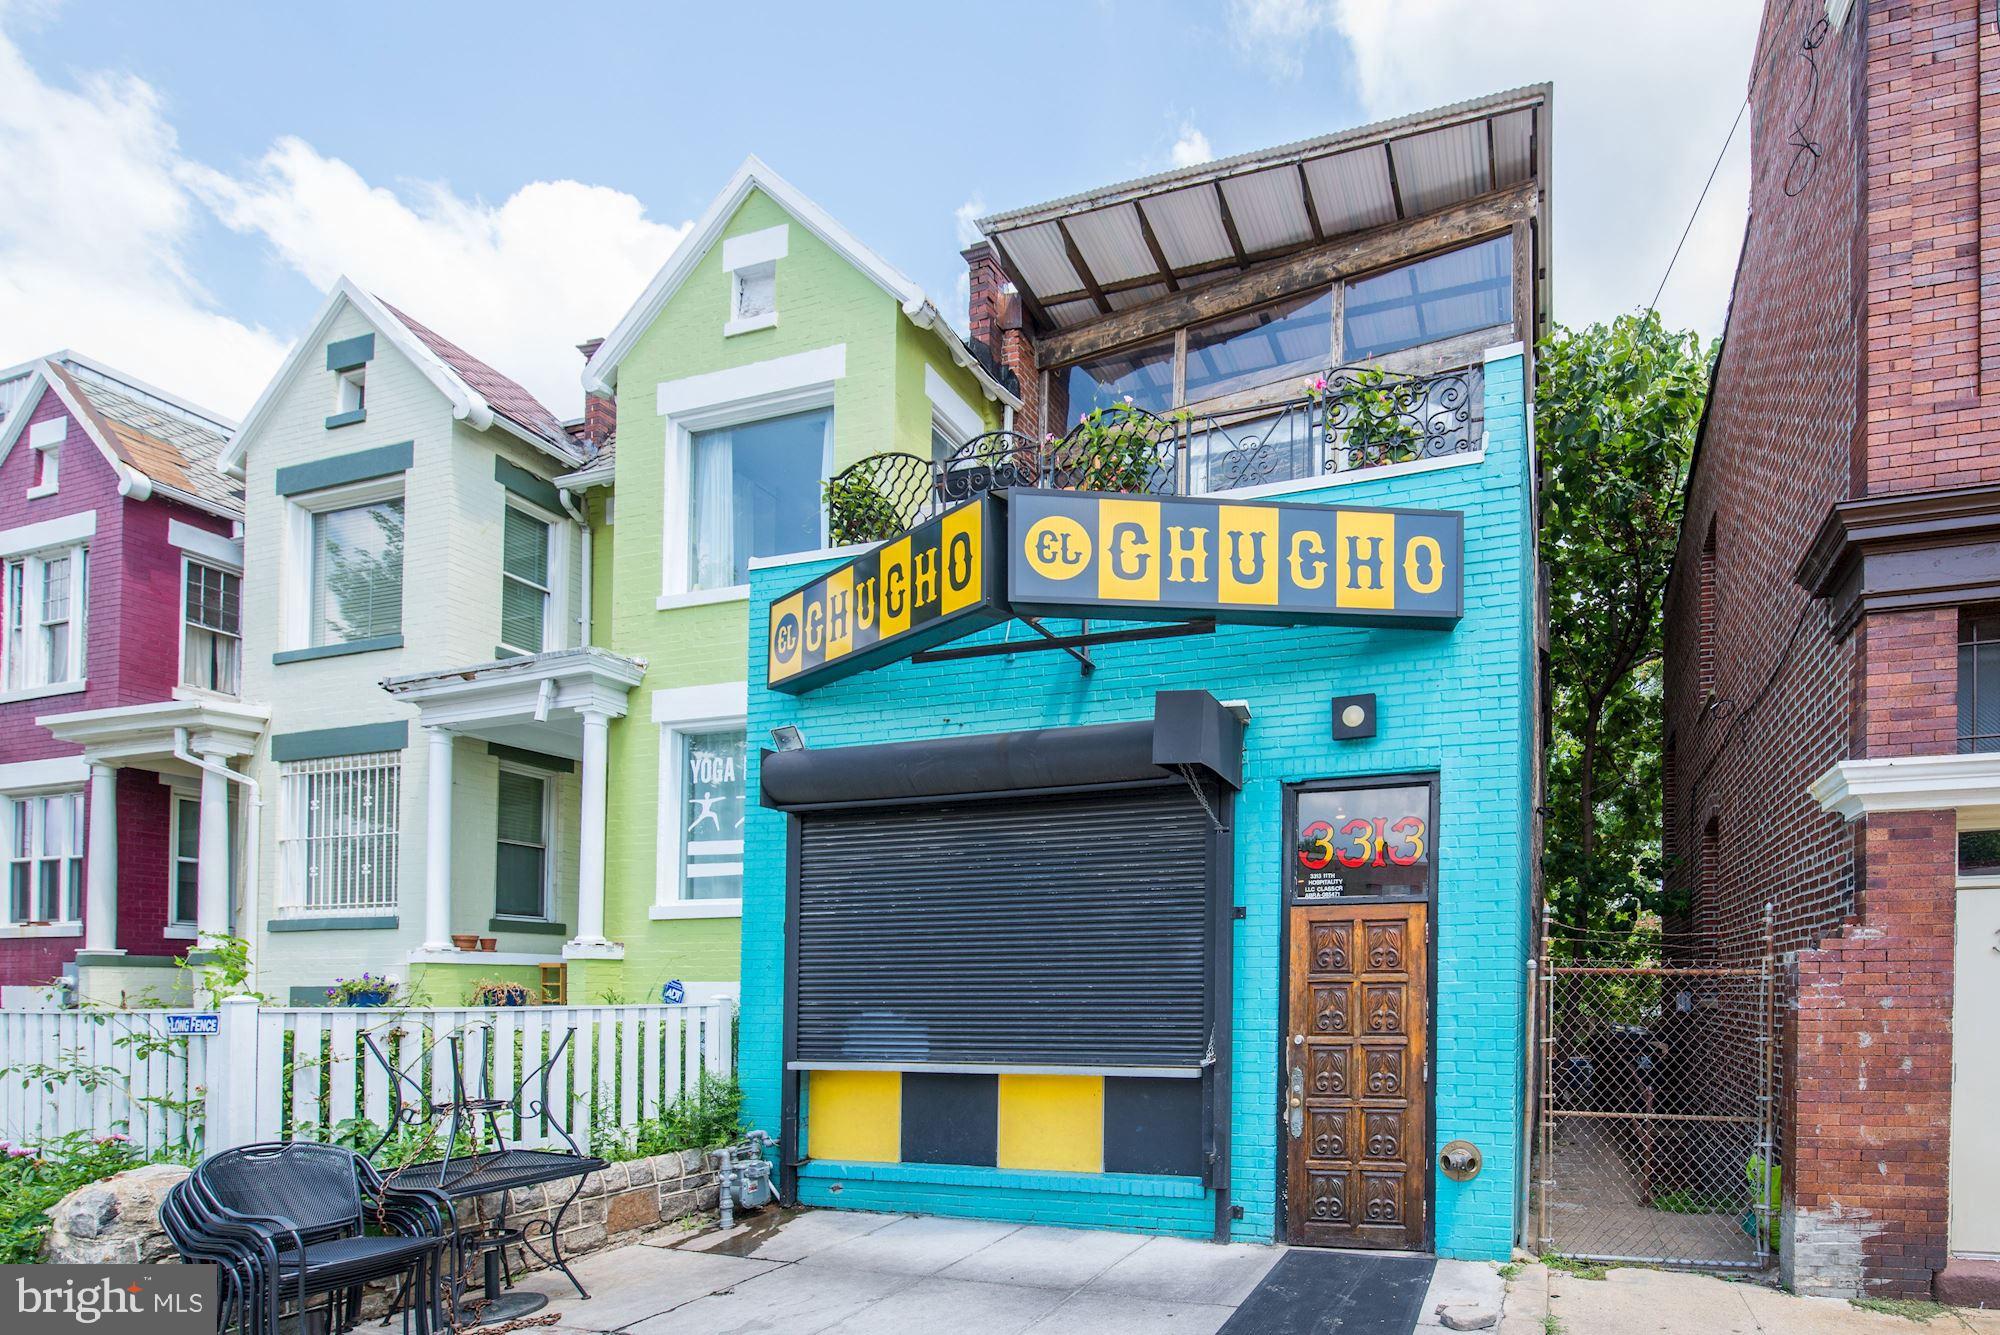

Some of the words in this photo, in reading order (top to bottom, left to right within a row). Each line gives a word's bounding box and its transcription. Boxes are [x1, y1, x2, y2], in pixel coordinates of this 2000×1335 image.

[1035, 530, 1082, 564] EL
[1108, 522, 1445, 594] CHUCHO
[777, 624, 797, 654] EL
[805, 531, 973, 652] CHUCHO
[690, 757, 735, 784] YOGA
[1298, 816, 1425, 870] 3313
[665, 987, 683, 1002] ADT
[170, 1017, 190, 1032] LONG
[190, 1016, 217, 1032] FENCE
